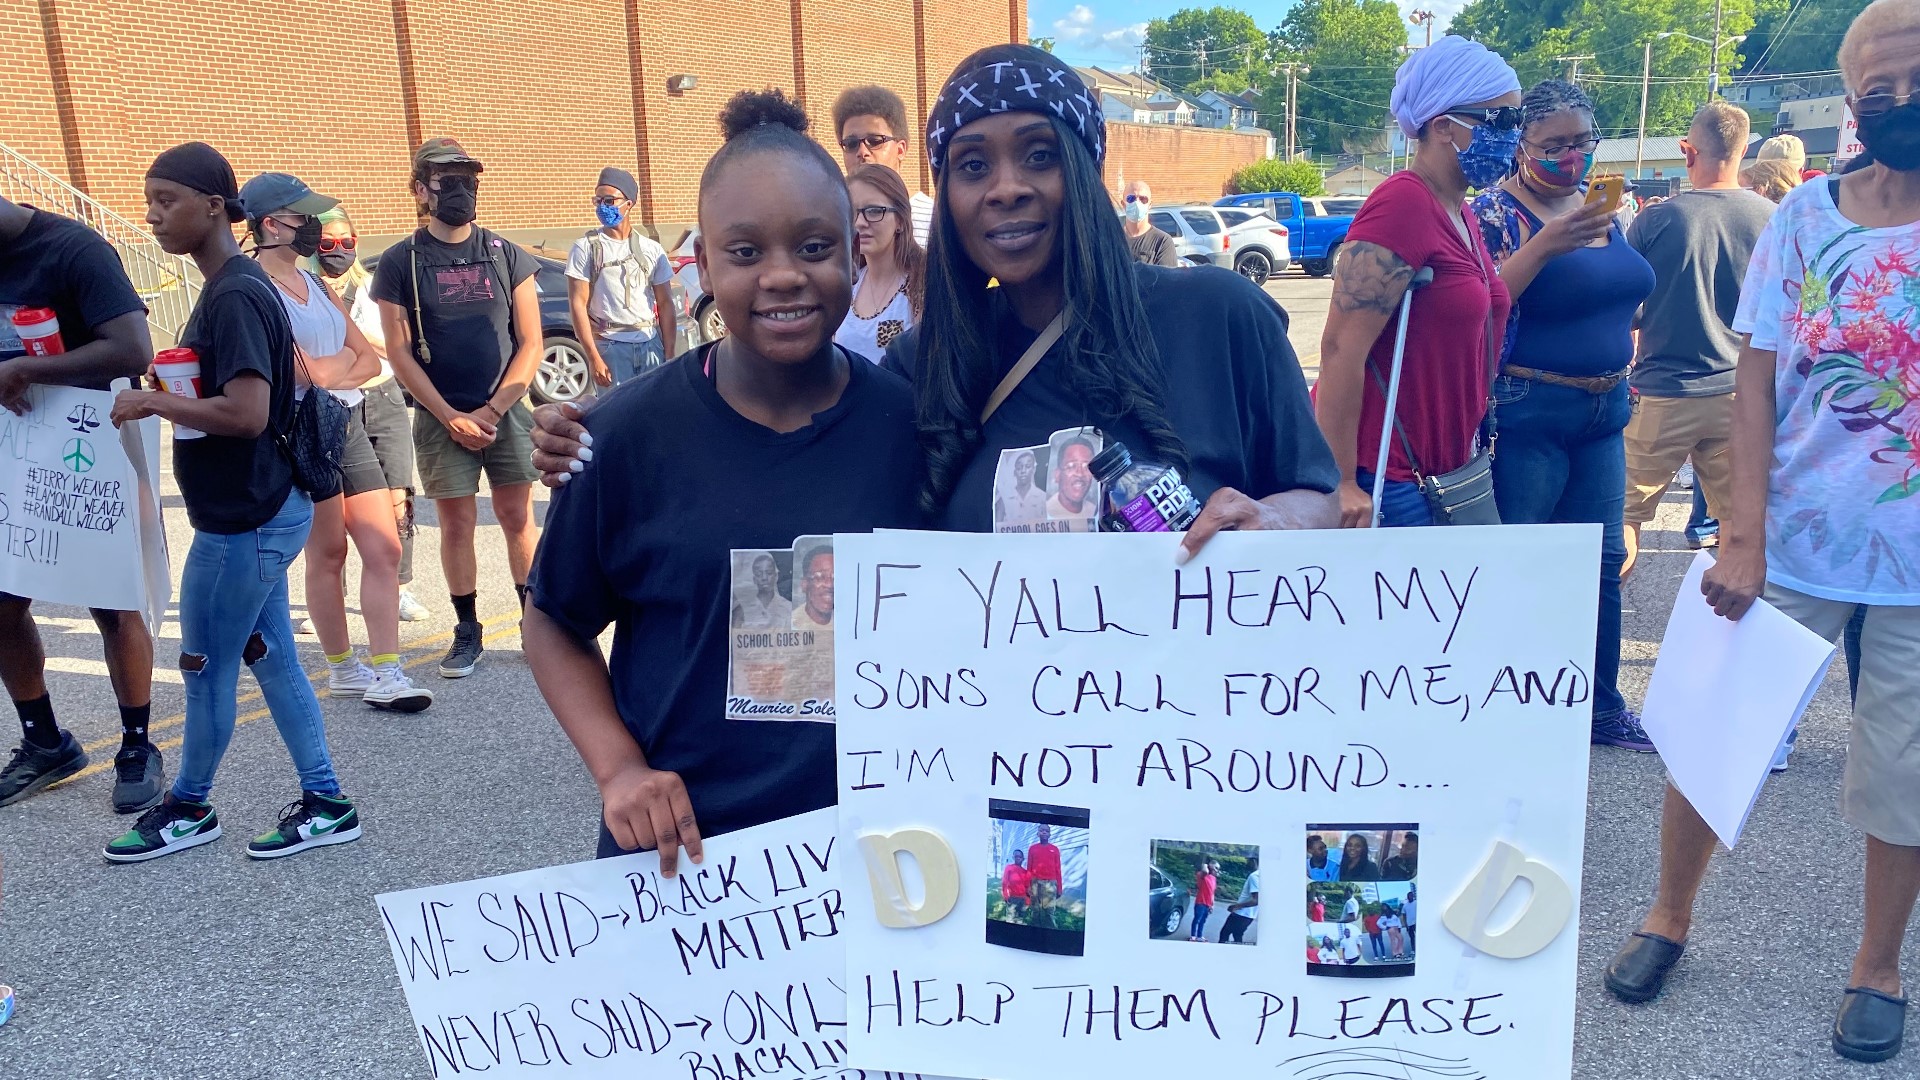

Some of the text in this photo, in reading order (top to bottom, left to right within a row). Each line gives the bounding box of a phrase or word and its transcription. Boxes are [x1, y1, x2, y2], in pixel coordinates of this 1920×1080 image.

[25, 483, 126, 519] #LAMONT WEAVER
[27, 467, 121, 499] #JERRY WEAVER
[0, 522, 59, 565] TER!!!
[23, 500, 119, 534] #RANDALL WILCOX
[854, 560, 1478, 654] IF YALL HEAR MY
[737, 631, 815, 648] SCHOOL GOES ON
[727, 697, 795, 715] Maurice
[853, 660, 987, 710] SONS
[1032, 665, 1196, 716] CALL
[1224, 666, 1336, 716] FOR
[1360, 665, 1469, 722] ME,
[1481, 659, 1589, 708] AND
[847, 738, 1449, 793] I'M NOT AROUND....
[382, 837, 835, 982] WE SAID BLACK LIV
[672, 889, 845, 975] MATTER
[421, 977, 847, 1078] NEVER SAID ONL
[865, 970, 1514, 1045] HELP THEM PLEASE.
